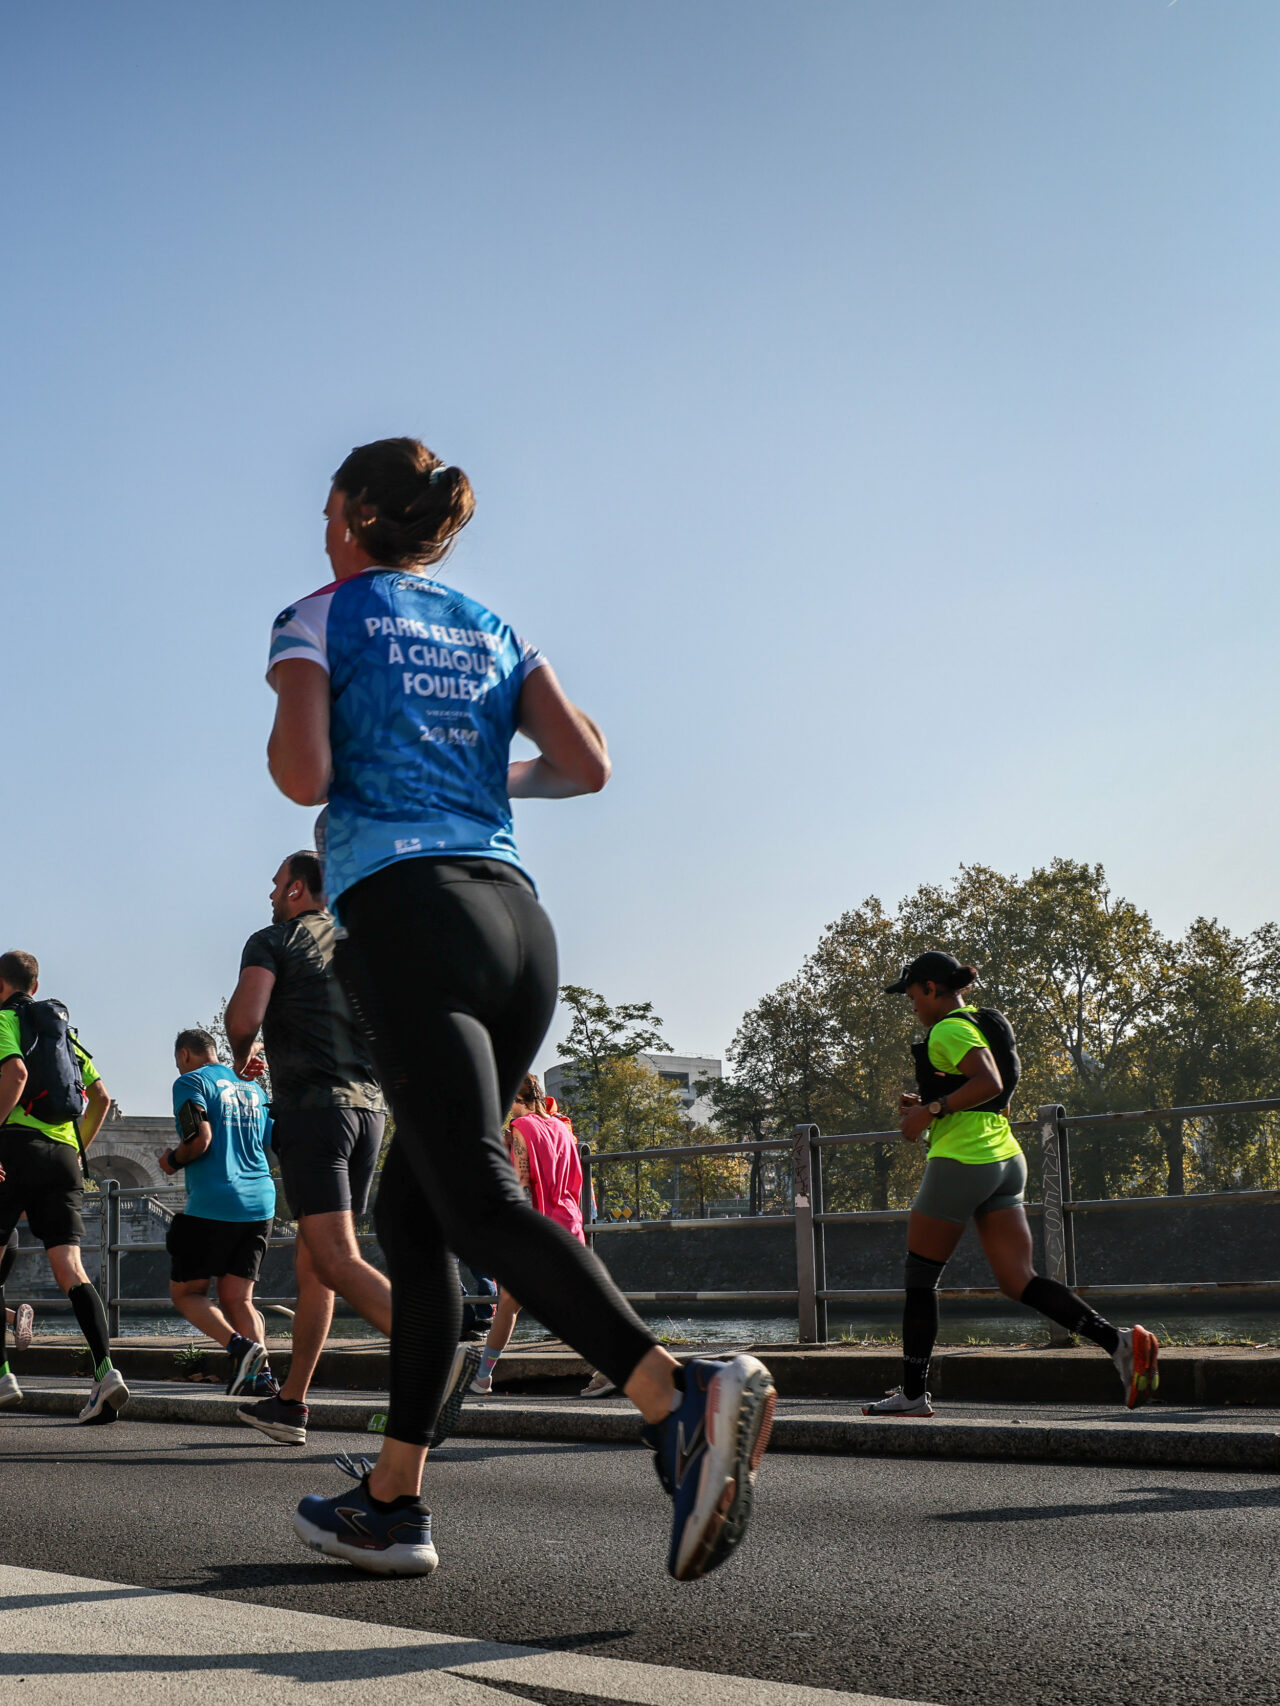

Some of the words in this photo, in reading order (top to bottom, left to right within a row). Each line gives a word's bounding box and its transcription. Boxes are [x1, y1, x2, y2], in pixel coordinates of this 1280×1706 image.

[365, 616, 429, 640] PARIS
[388, 637, 405, 665] À
[408, 645, 497, 678] CHAQUE
